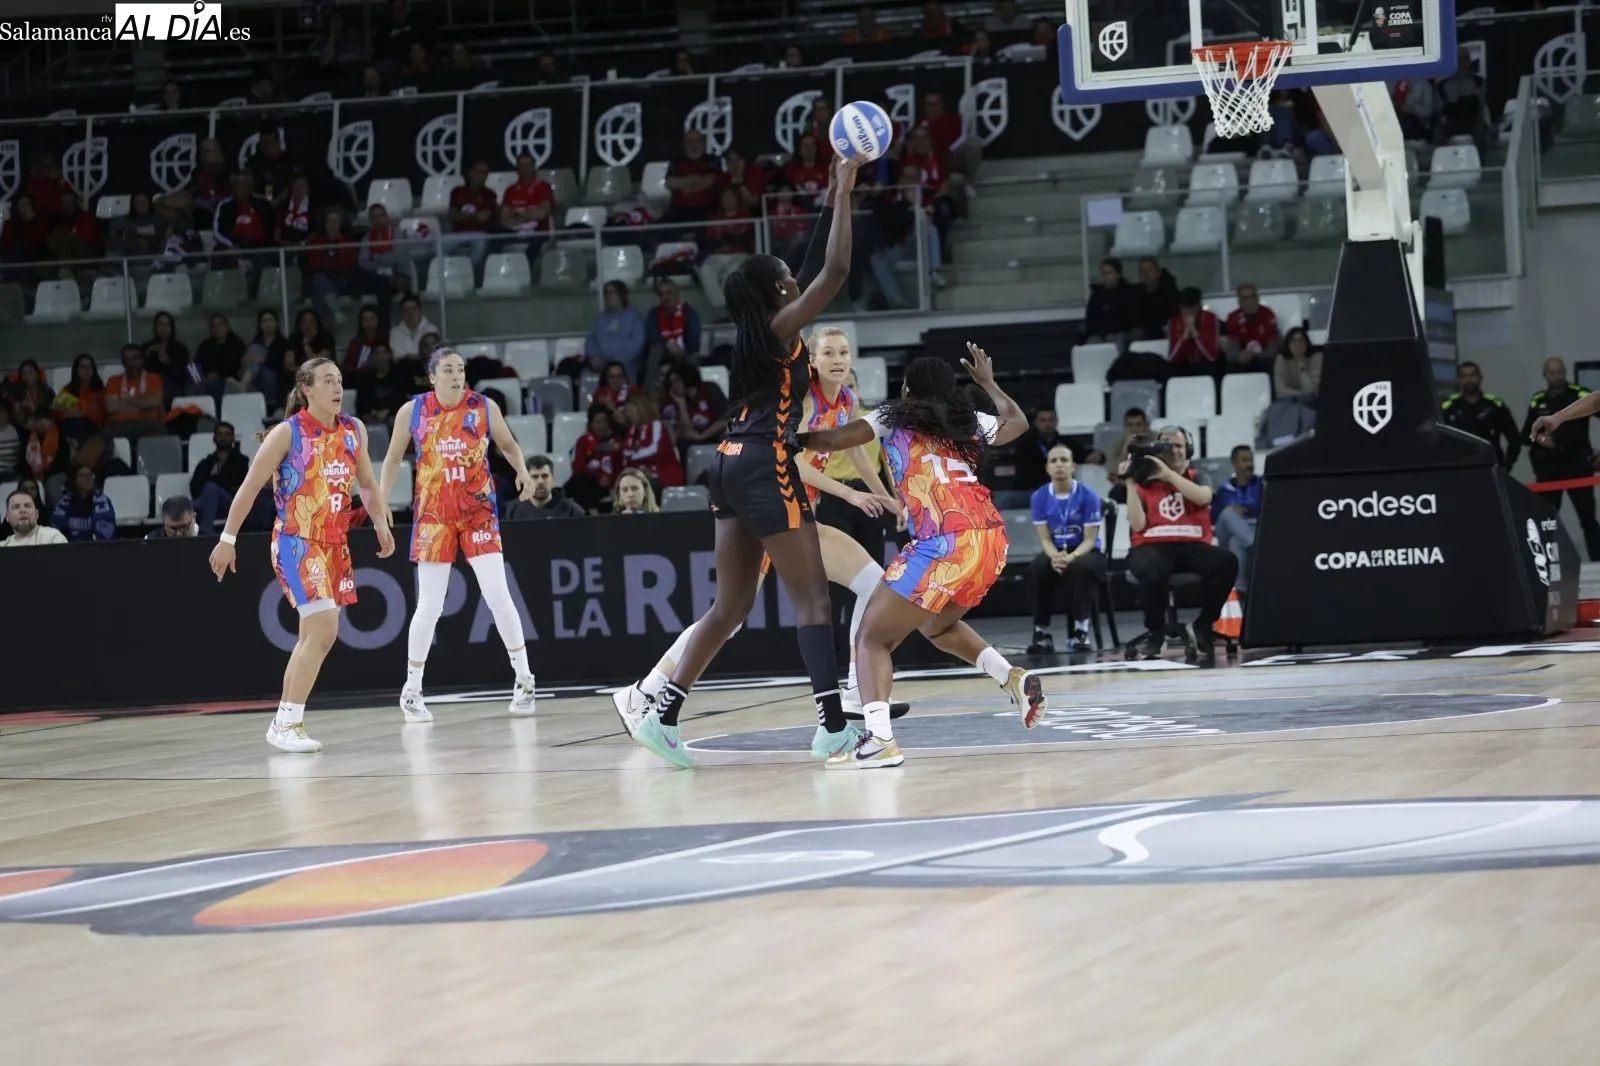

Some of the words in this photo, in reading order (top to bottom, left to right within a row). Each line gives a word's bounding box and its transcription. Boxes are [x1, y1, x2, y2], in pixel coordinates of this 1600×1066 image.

[852, 115, 874, 153] Wilson
[441, 466, 466, 484] 14
[921, 453, 977, 485] 15
[1318, 491, 1436, 520] endesa
[1315, 551, 1371, 570] COPA
[1371, 550, 1383, 558] DE
[1372, 559, 1384, 567] LA
[1384, 547, 1444, 566] REINA
[551, 557, 604, 594] DE
[553, 598, 612, 638] LA
